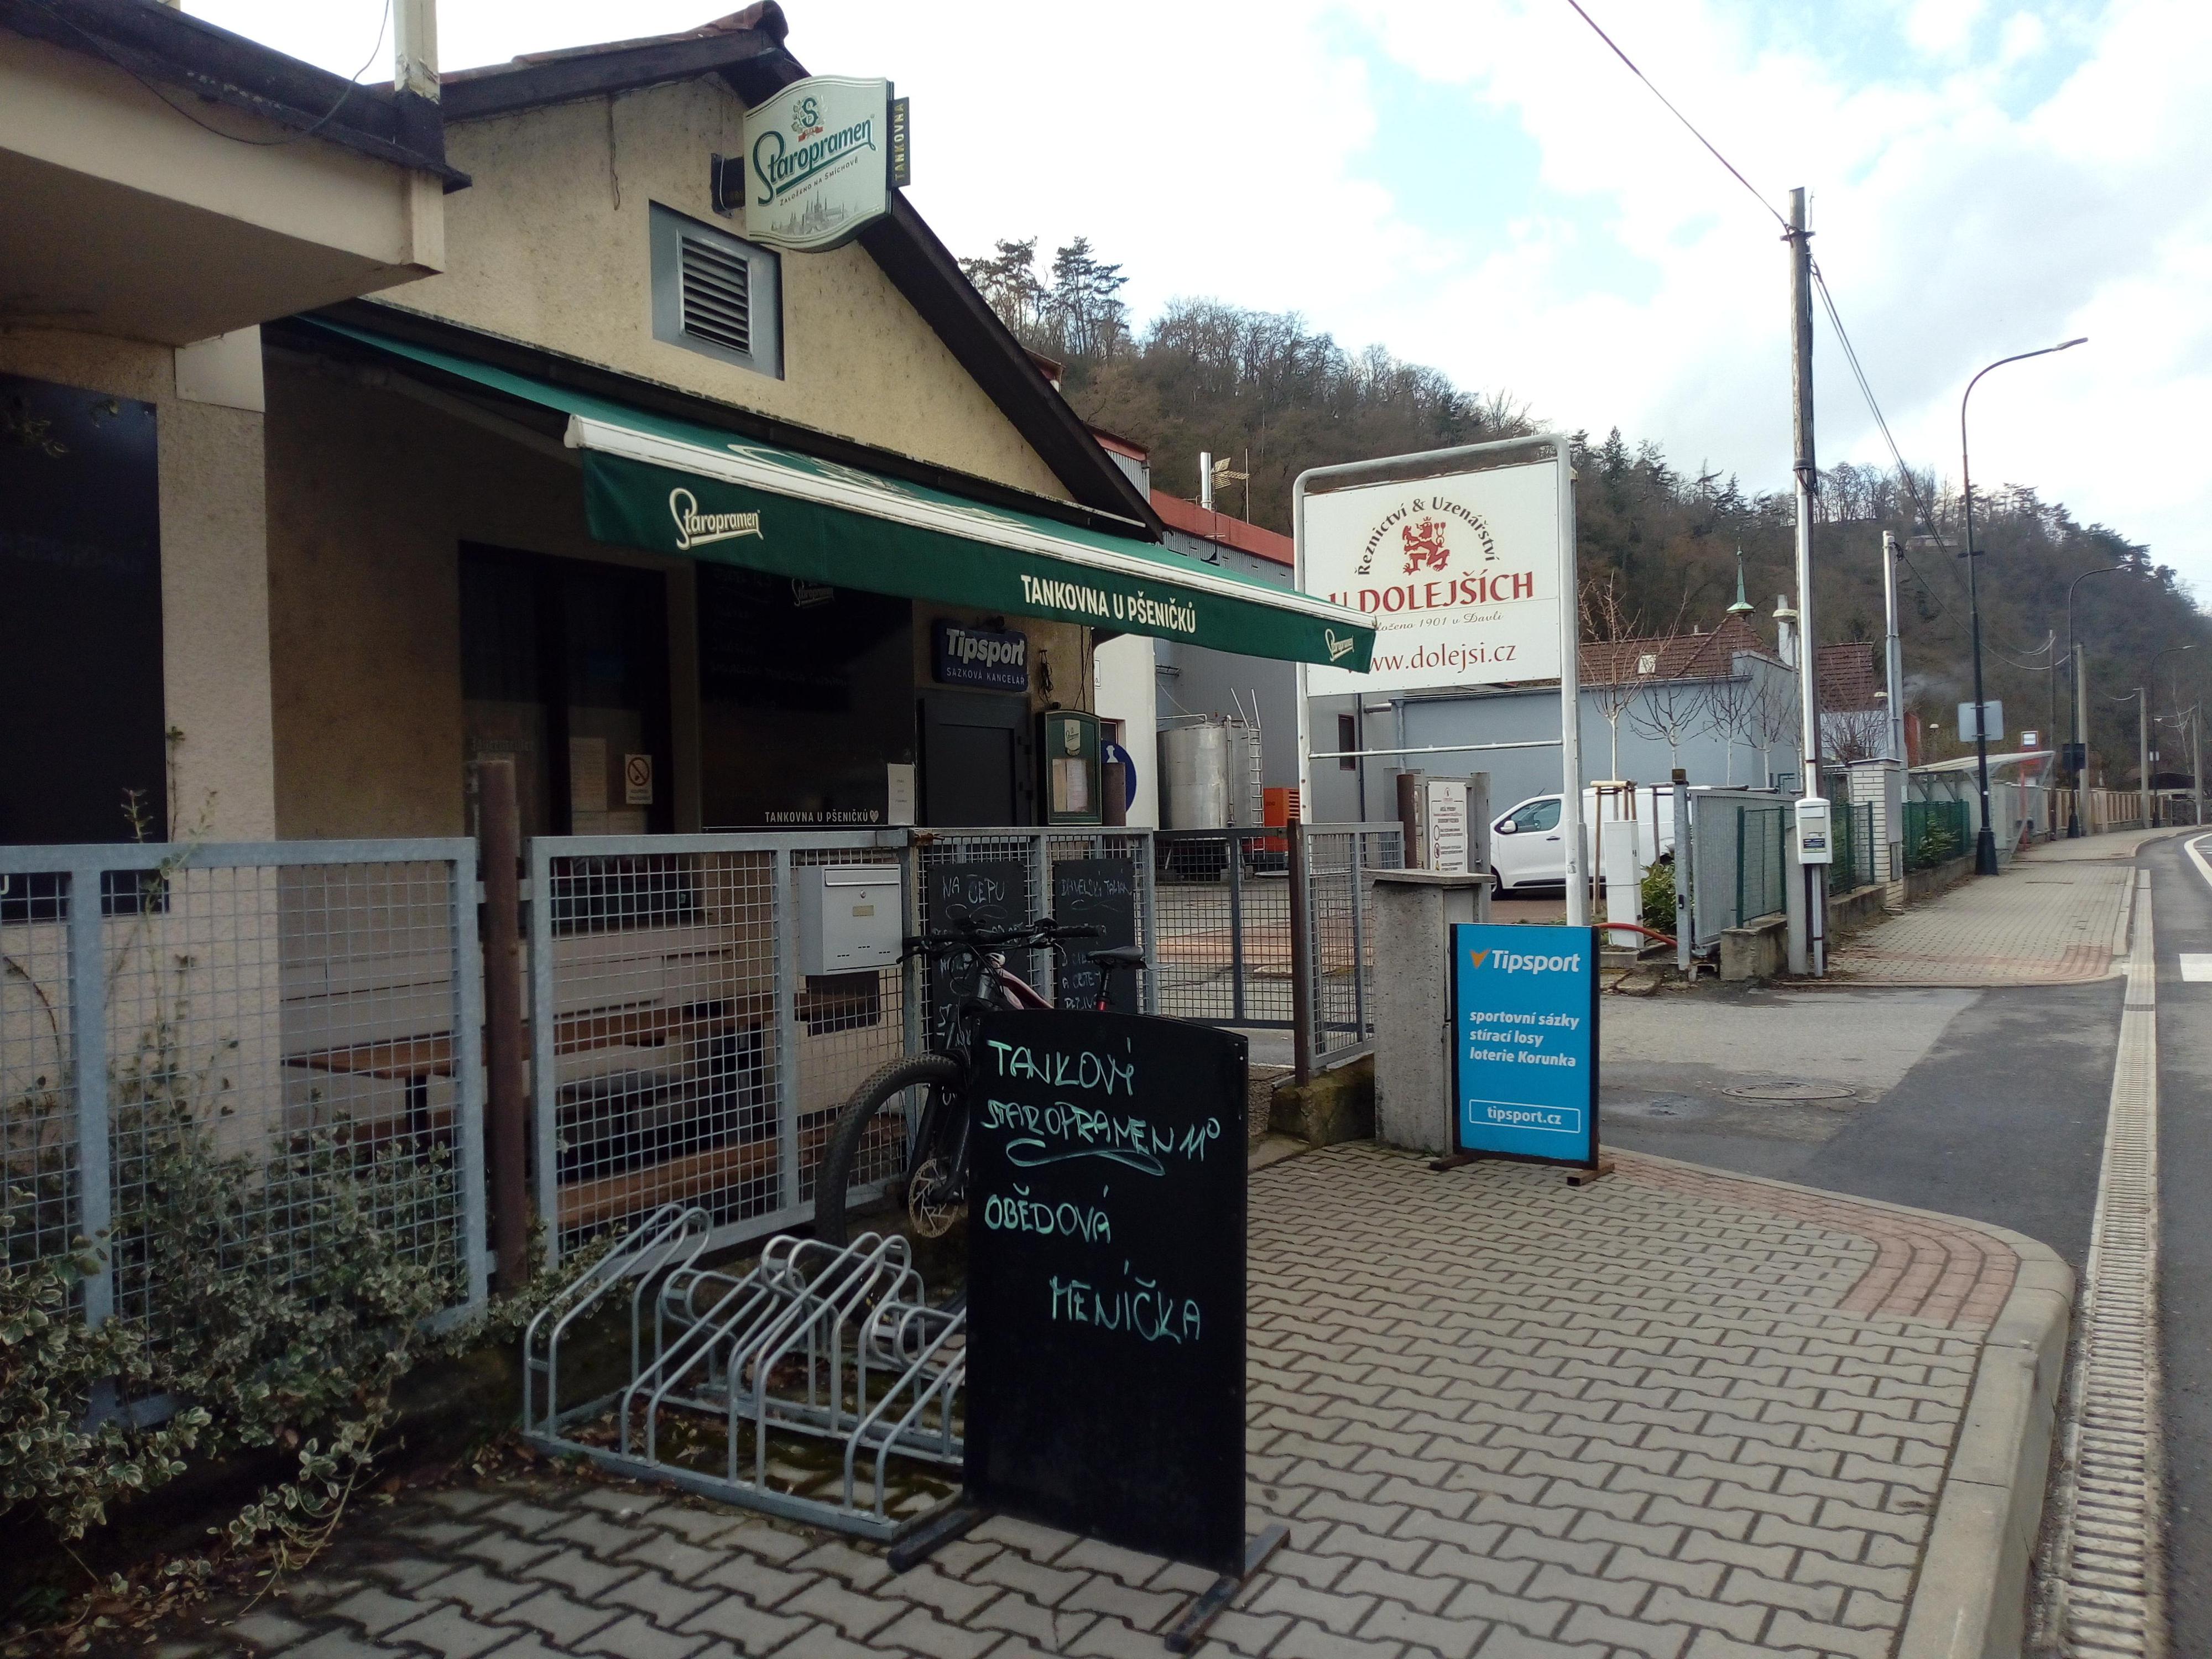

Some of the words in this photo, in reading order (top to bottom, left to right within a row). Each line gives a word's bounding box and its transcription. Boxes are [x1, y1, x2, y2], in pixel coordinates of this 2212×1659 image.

[894, 103, 905, 181] TANKOVNA
[753, 118, 878, 206] Staropramen
[669, 487, 764, 551] Staropramen
[1354, 503, 1407, 575] Řeznictví
[1412, 498, 1426, 513] &
[1432, 497, 1500, 562] Uzenářství
[1020, 573, 1110, 618] TANKOVNA
[1113, 593, 1124, 620] U
[1128, 589, 1196, 634] PŠENIČKŮ
[1359, 569, 1534, 613] DOLEJŠÍCH
[1420, 617, 1447, 628] 1901
[1463, 610, 1504, 623] Davli
[946, 628, 1025, 667] Tipsport
[1348, 642, 1517, 673] ww.dolejsi.cz
[765, 811, 814, 823] TANKOVNA
[817, 812, 822, 822] U
[827, 808, 868, 822] PŠENIČKŮ
[942, 875, 959, 901] NA
[1492, 950, 1581, 975] Tipsport
[1469, 1010, 1536, 1025] sportovní
[1538, 1013, 1579, 1030] sázky
[1469, 1029, 1511, 1042] stírací
[1514, 1030, 1544, 1047] losy
[1469, 1047, 1515, 1063] loterie
[1518, 1051, 1576, 1067] Korunka
[1487, 1105, 1562, 1125] tipsport.cz
[984, 1182, 1111, 1244] OBĚDOVÁ
